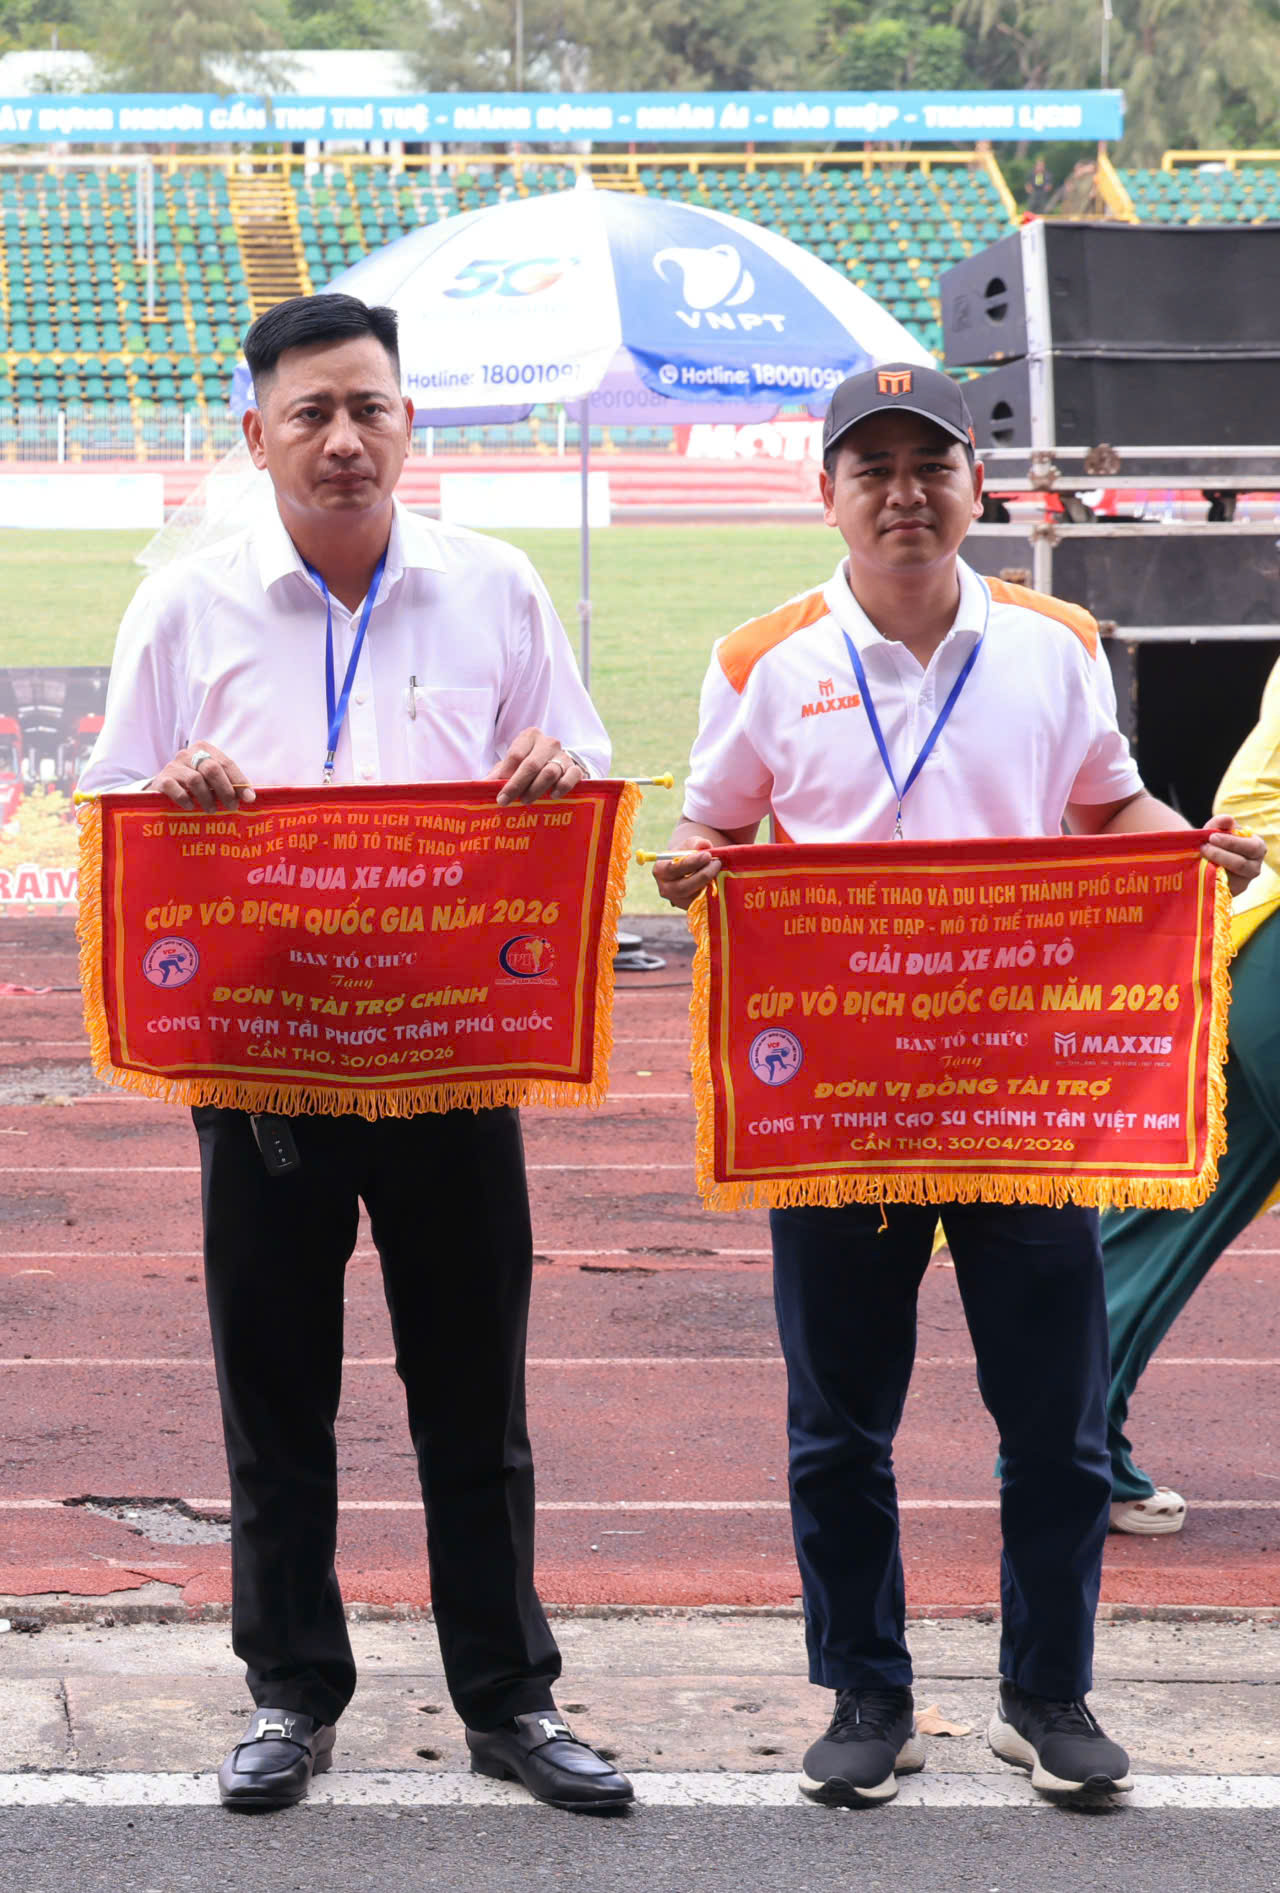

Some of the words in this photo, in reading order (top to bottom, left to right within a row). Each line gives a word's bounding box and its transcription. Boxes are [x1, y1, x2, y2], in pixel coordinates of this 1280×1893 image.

[676, 310, 786, 332] VNPT
[407, 372, 474, 388] Hotline:
[682, 367, 750, 385] Hotline:
[801, 694, 861, 718] MAXXIS
[744, 887, 766, 909] SỞ
[771, 886, 801, 908] VĂN
[848, 879, 877, 905] THỂ
[881, 887, 923, 905] THAO
[927, 884, 948, 905] VÀ
[953, 888, 975, 905] DU
[980, 885, 1015, 908] LỊCH
[1020, 880, 1073, 902] THÀNH
[1078, 872, 1109, 898] PHỐ
[1115, 871, 1148, 896] CẦN
[1154, 871, 1183, 893] THƠ
[784, 914, 816, 936] LIÊN
[822, 915, 863, 935] ĐOÀN
[870, 918, 888, 935] XE
[893, 919, 924, 939] ĐẠP
[941, 914, 964, 935] MÔ
[970, 914, 988, 933] TÔ
[994, 908, 1021, 931] THỂ
[1025, 911, 1064, 929] THAO
[1070, 906, 1101, 928] VIỆT
[1106, 906, 1143, 924] NAM
[849, 944, 901, 974] GIẢI
[905, 951, 952, 975] ĐUA
[958, 948, 992, 973] XE
[994, 939, 1036, 968] MÔ
[1043, 937, 1075, 966] TÔ
[213, 984, 272, 1004] ĐƠN
[279, 992, 303, 1011] VỊ
[309, 995, 347, 1016] TÀI
[354, 993, 404, 1016] TRỢ
[410, 985, 488, 1009] CHÍNH
[747, 986, 794, 1020] CÚP
[801, 984, 840, 1016] VÔ
[843, 991, 905, 1023] ĐỊCH
[911, 978, 984, 1021] QUỐC
[989, 984, 1035, 1012] GIA
[1040, 976, 1102, 1012] NĂM
[1107, 984, 1180, 1012] 2026
[147, 1016, 200, 1033] CÔNG
[207, 1017, 231, 1032] TY
[236, 1016, 279, 1039] VẬN
[287, 1019, 318, 1039] TẢI
[394, 1019, 448, 1040] TRÂM
[455, 1014, 494, 1033] PHÚ
[501, 1010, 552, 1031] QUỐC
[896, 1036, 937, 1050] BAN
[940, 1028, 966, 1049] TỔ
[971, 1030, 1028, 1047] CHỨC
[1081, 1036, 1173, 1054] MAXXIS
[814, 1079, 878, 1099] ĐƠN
[885, 1082, 912, 1102] VỊ
[916, 1074, 999, 1098] ĐỒNG
[1007, 1075, 1049, 1095] TÀI
[1056, 1077, 1112, 1101] TRỢ
[748, 1116, 795, 1135] CÔNG
[800, 1113, 824, 1130] TY
[832, 1112, 887, 1128] TNHH
[894, 1112, 934, 1128] CAO
[941, 1110, 966, 1126] SU
[973, 1107, 1036, 1127] CHÍNH
[1044, 1108, 1085, 1128] TÂN
[1093, 1111, 1137, 1132] VIỆT
[1143, 1114, 1180, 1130] NAM
[850, 1132, 897, 1150] CẦN
[900, 1136, 942, 1151] THƠ,
[948, 1137, 1075, 1151] 30/04/2026
